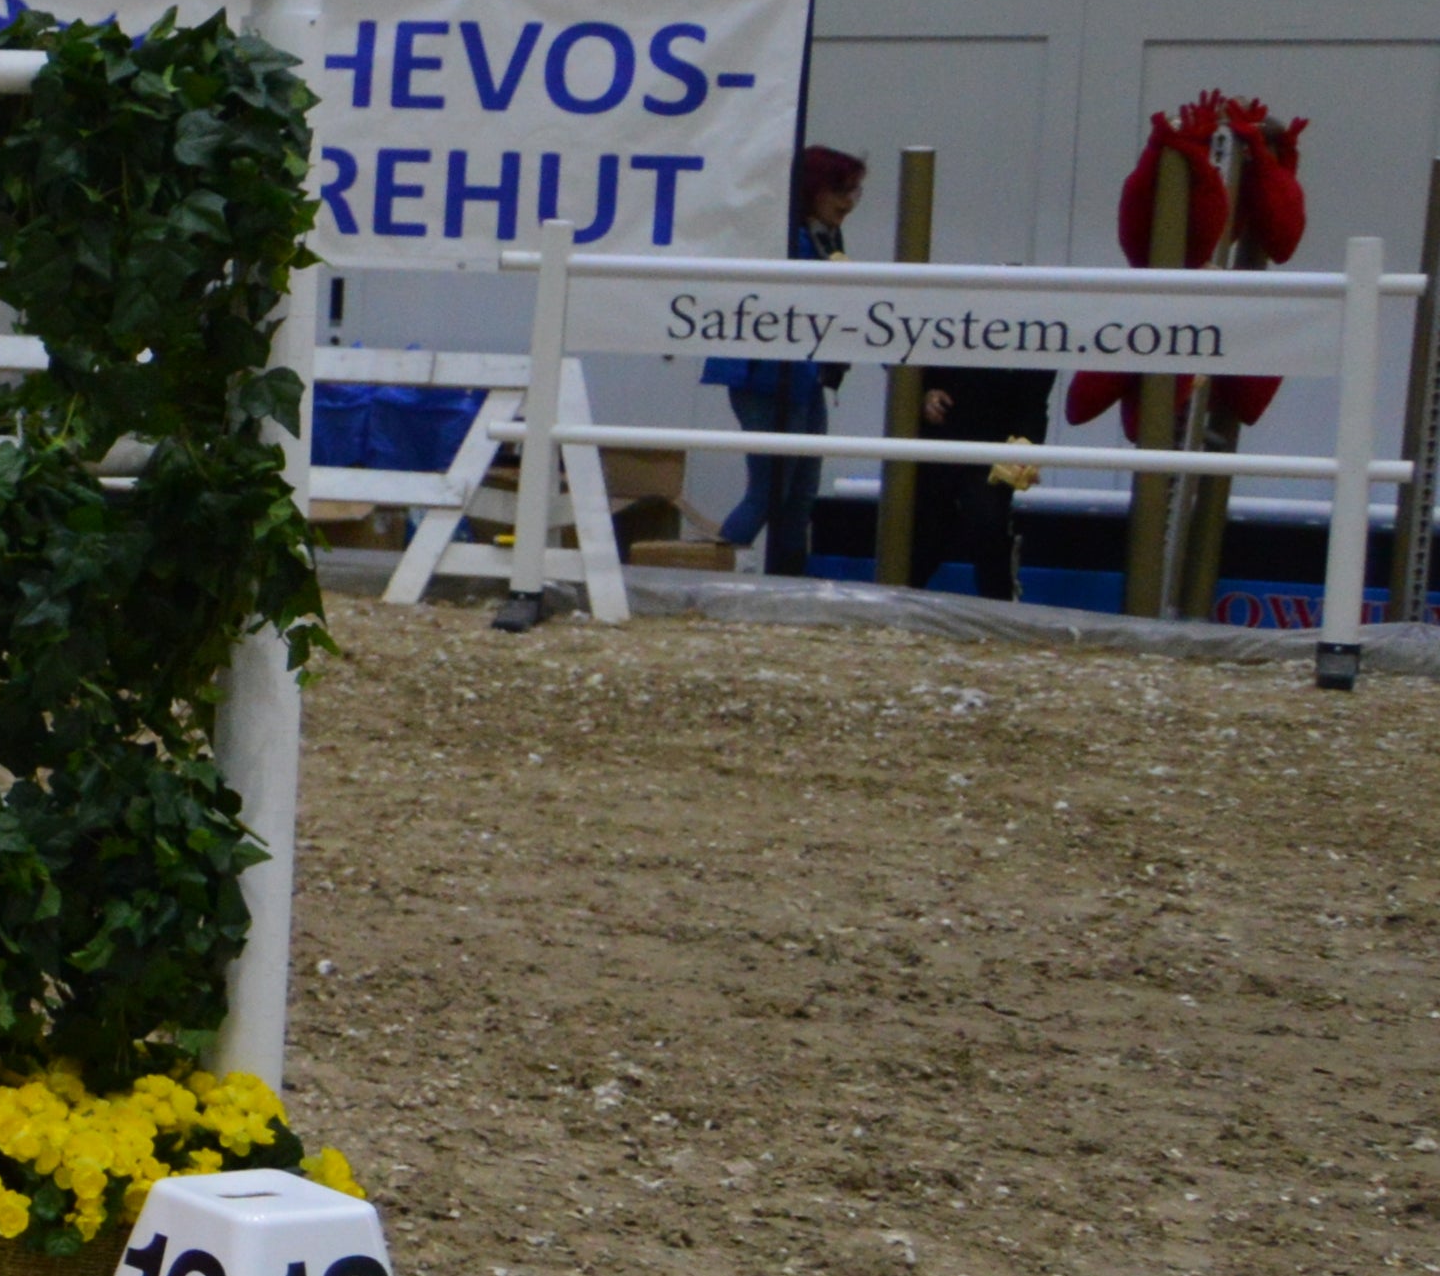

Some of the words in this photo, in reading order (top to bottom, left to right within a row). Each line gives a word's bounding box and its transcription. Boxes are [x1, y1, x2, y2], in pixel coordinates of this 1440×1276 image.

[325, 20, 755, 116] HEVOS-
[321, 147, 704, 246] REHUT
[667, 293, 1223, 364] Safety-System.com
